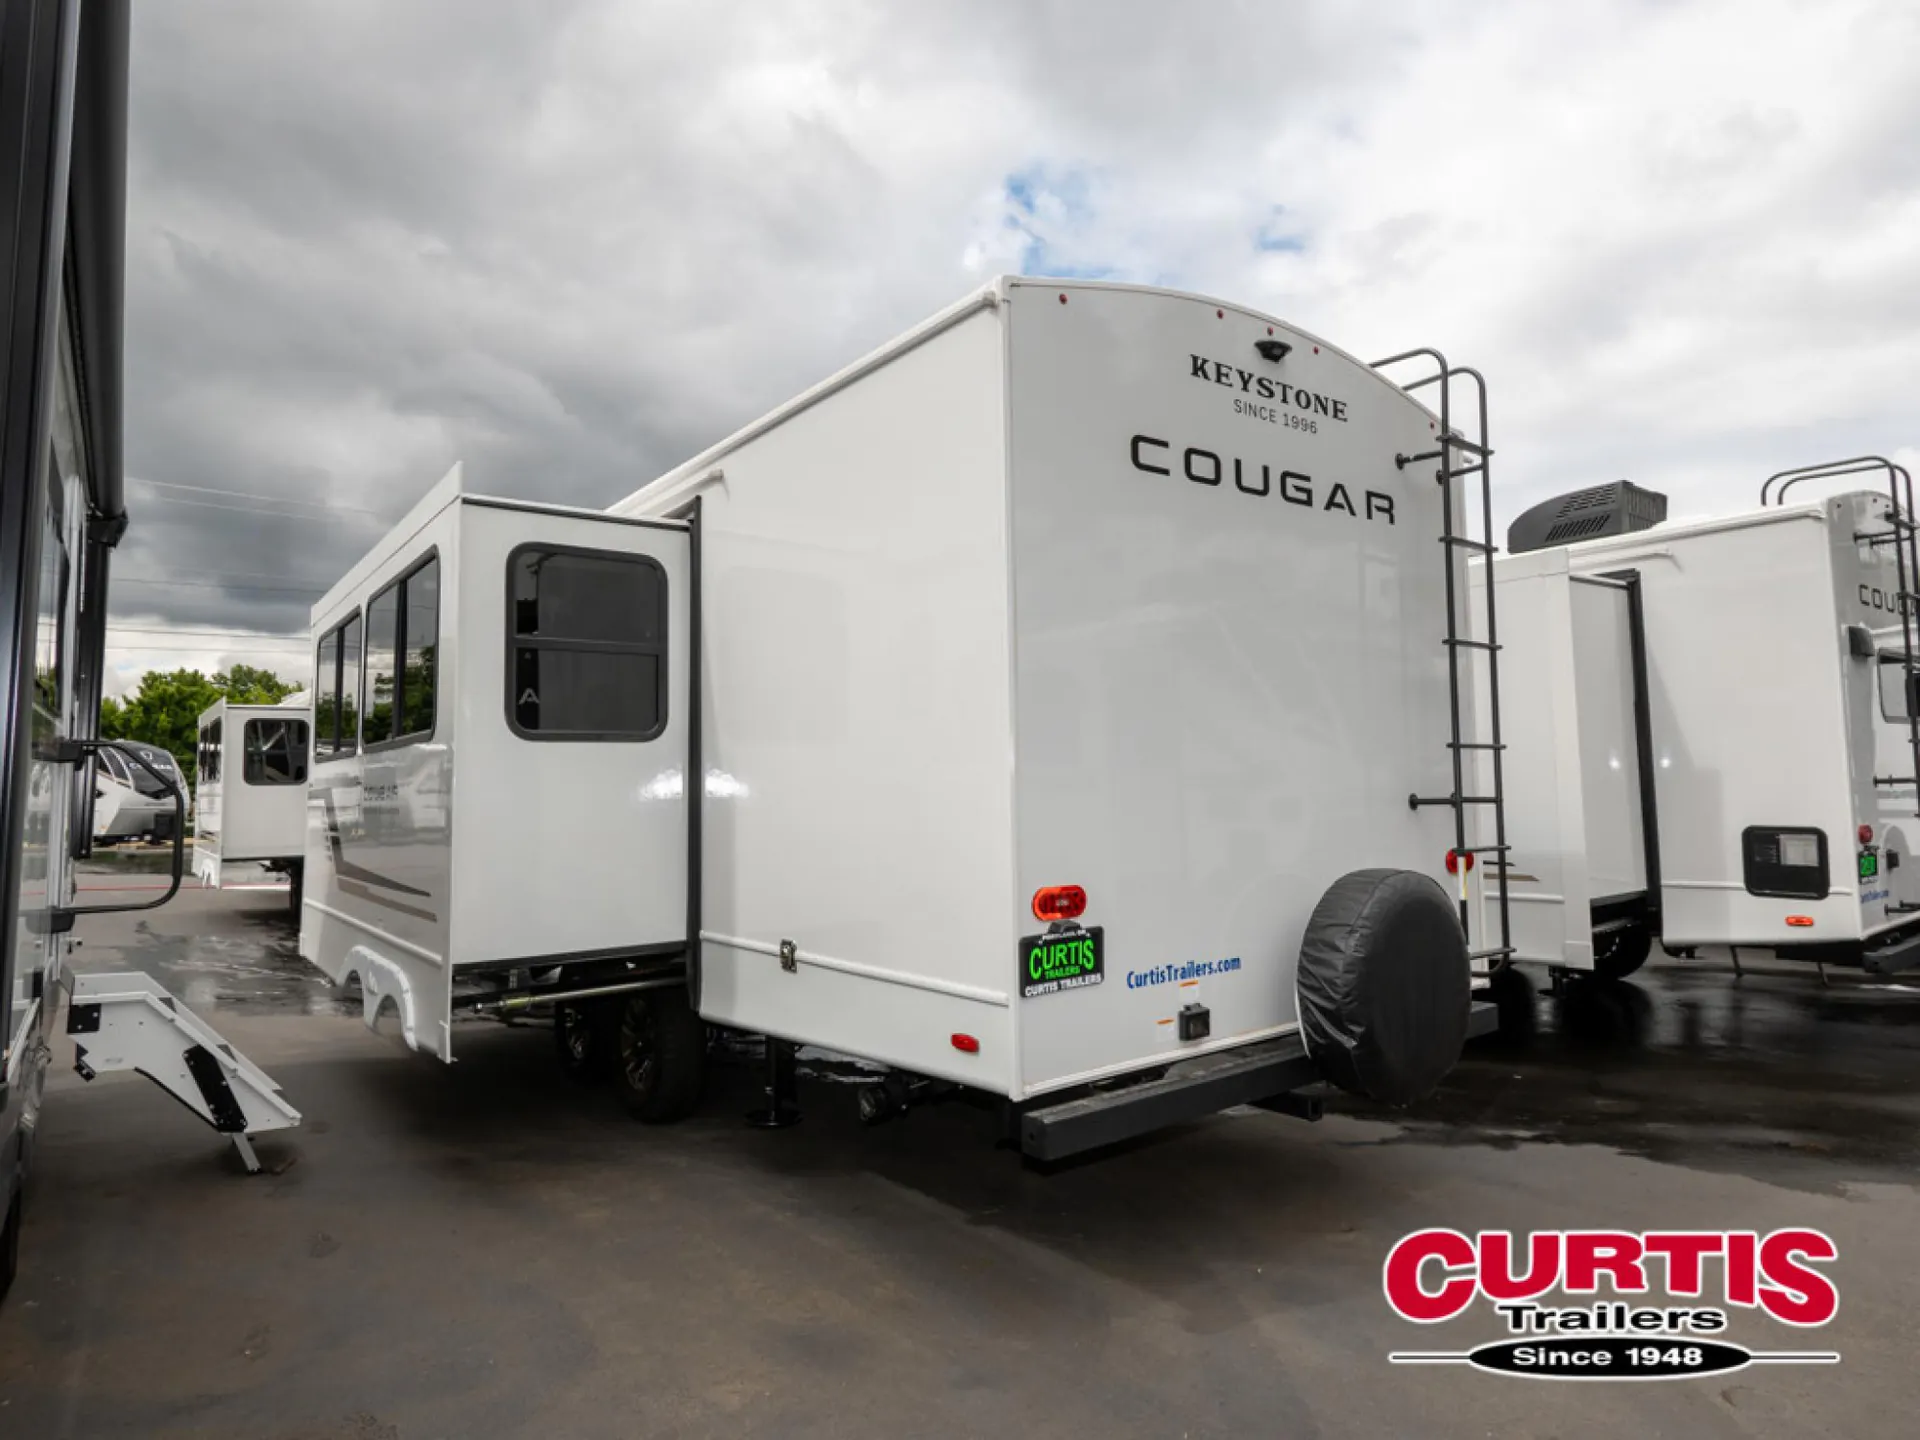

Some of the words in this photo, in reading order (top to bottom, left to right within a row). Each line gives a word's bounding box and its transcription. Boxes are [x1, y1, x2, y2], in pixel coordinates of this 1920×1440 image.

[1190, 354, 1348, 422] KEYSTONE
[1233, 398, 1277, 424] SINCE
[1283, 413, 1318, 434] 1996
[1130, 434, 1395, 525] COUGAR
[1029, 939, 1095, 980] CURTIS
[1126, 956, 1242, 989] CurtisTrailers.com
[1025, 981, 1059, 997] CURTIS
[1059, 972, 1101, 990] TRAILERS
